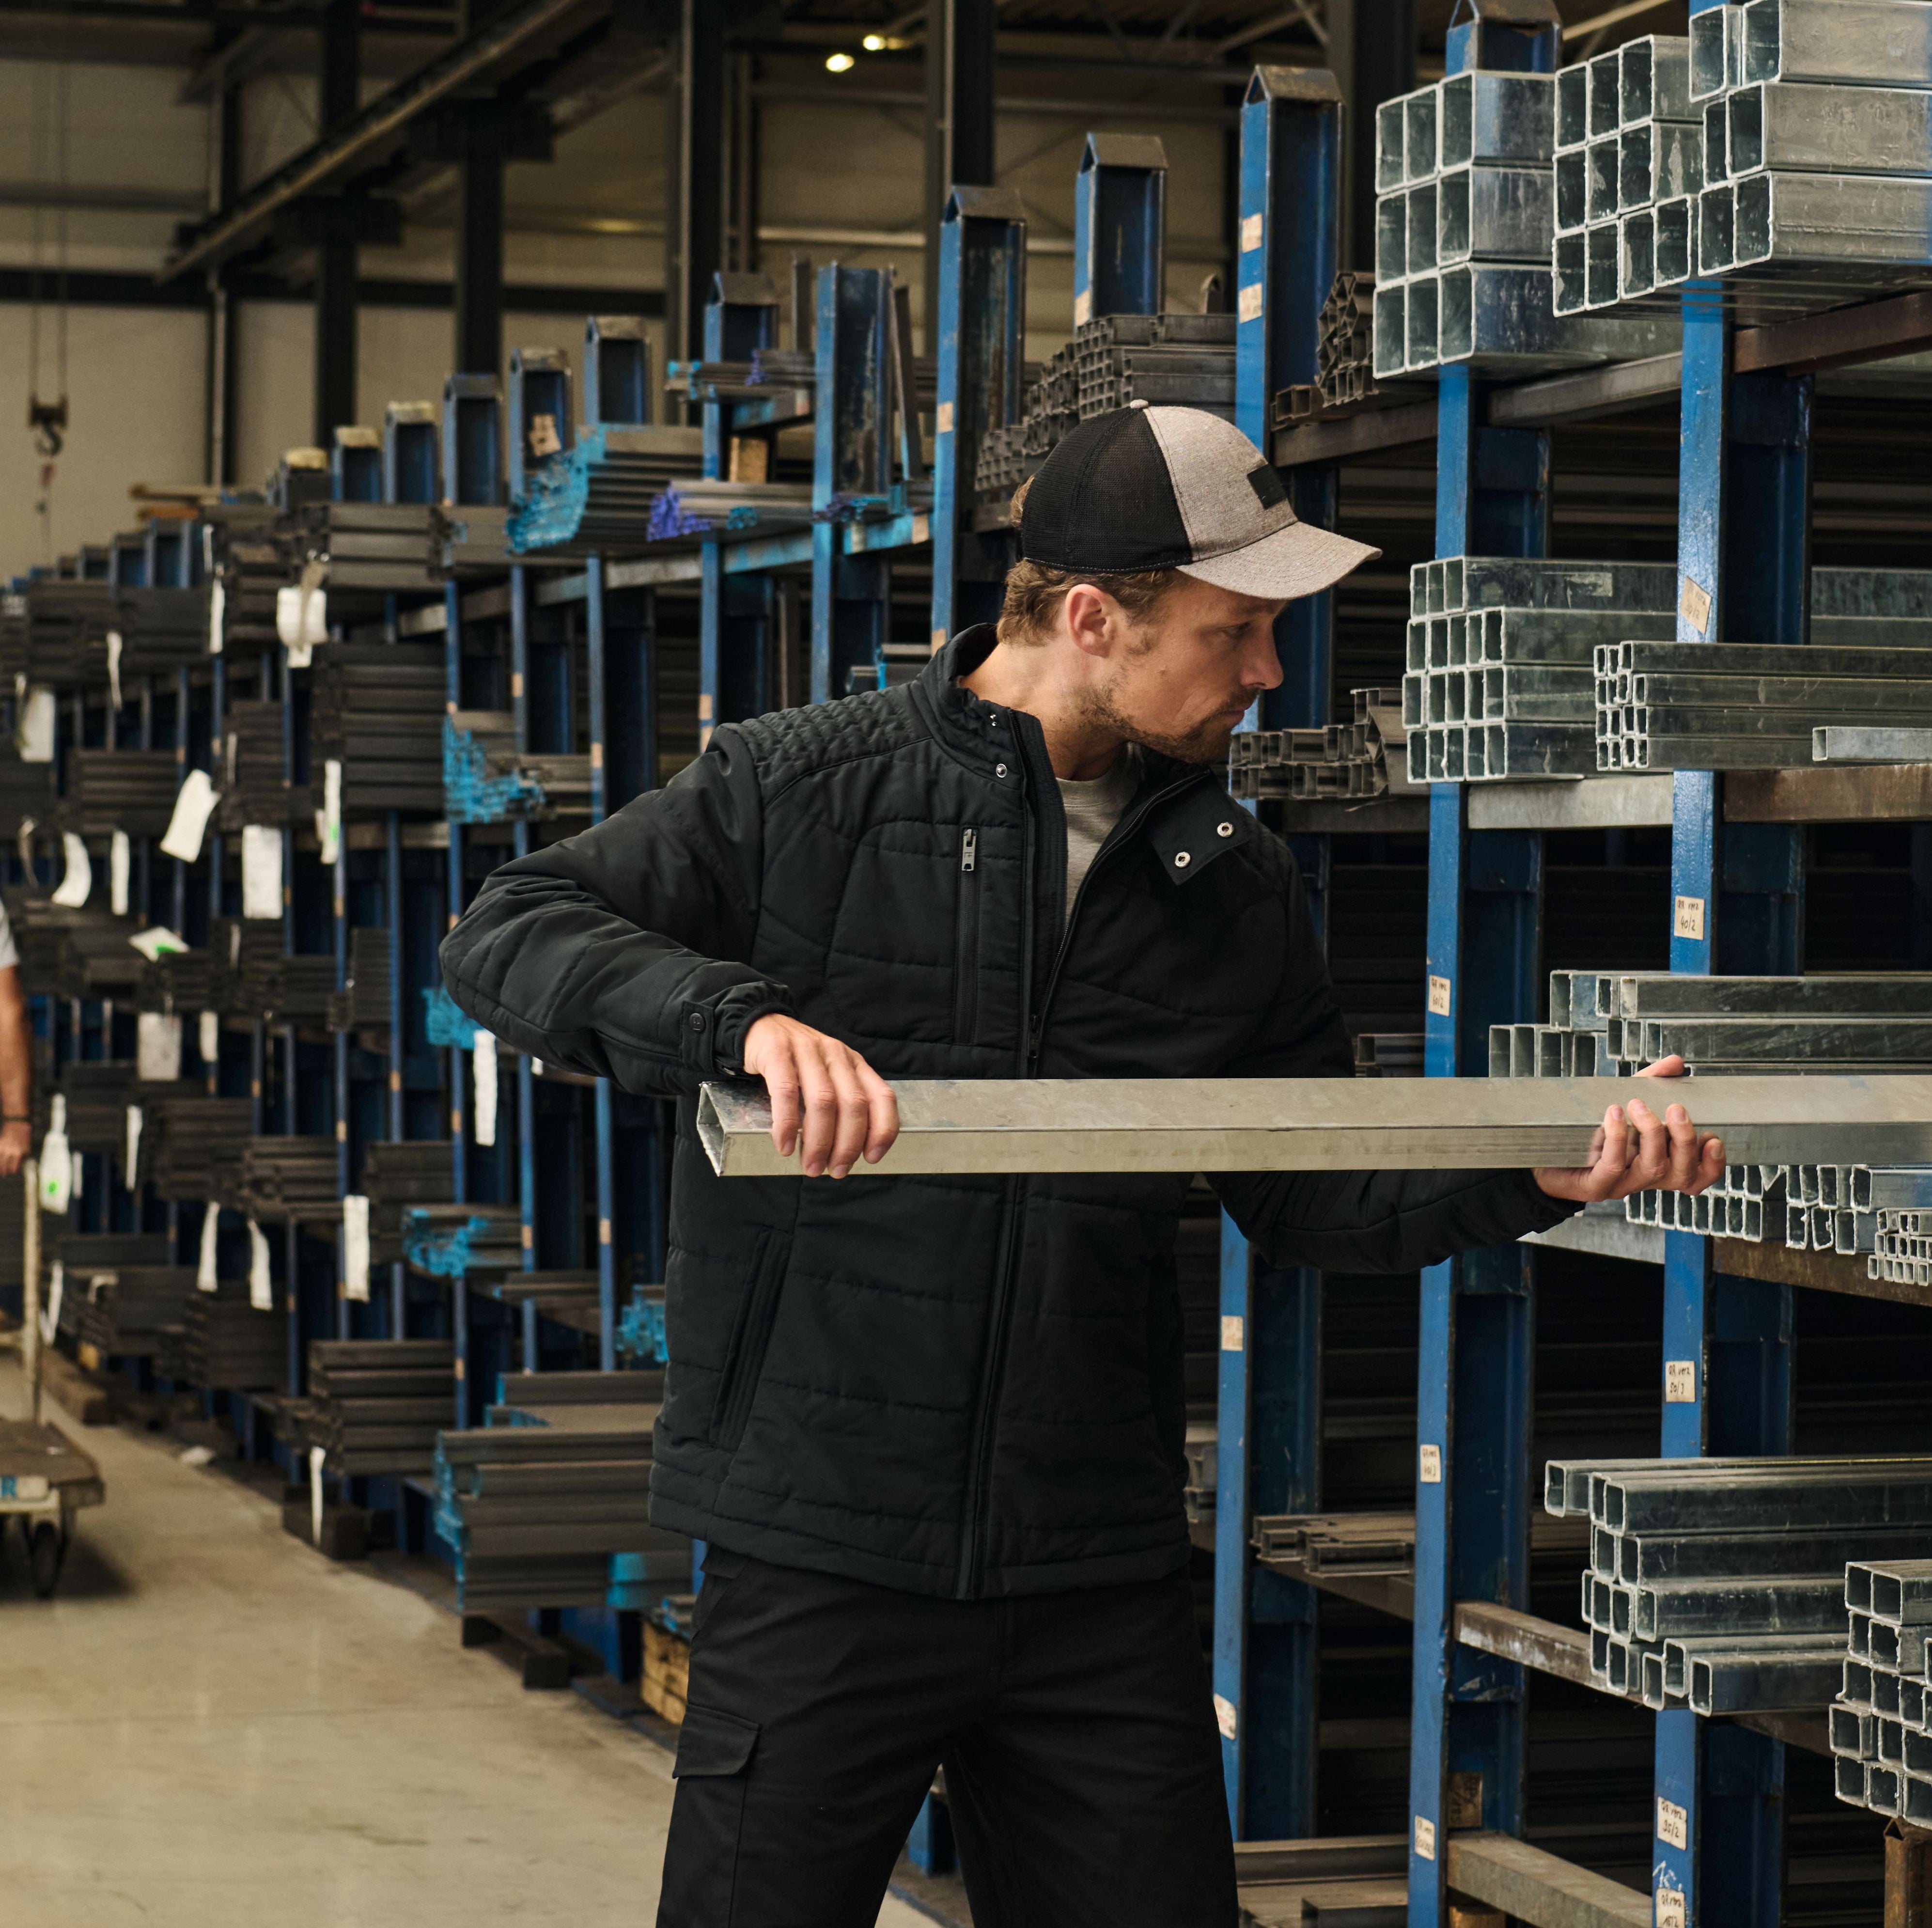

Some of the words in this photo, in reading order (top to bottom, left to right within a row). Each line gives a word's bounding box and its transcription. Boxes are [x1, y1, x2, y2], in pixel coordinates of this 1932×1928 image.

[1681, 915, 1696, 932] 40/2
[1670, 1380, 1684, 1395] 50/3
[1663, 1819, 1679, 1838] 35/2
